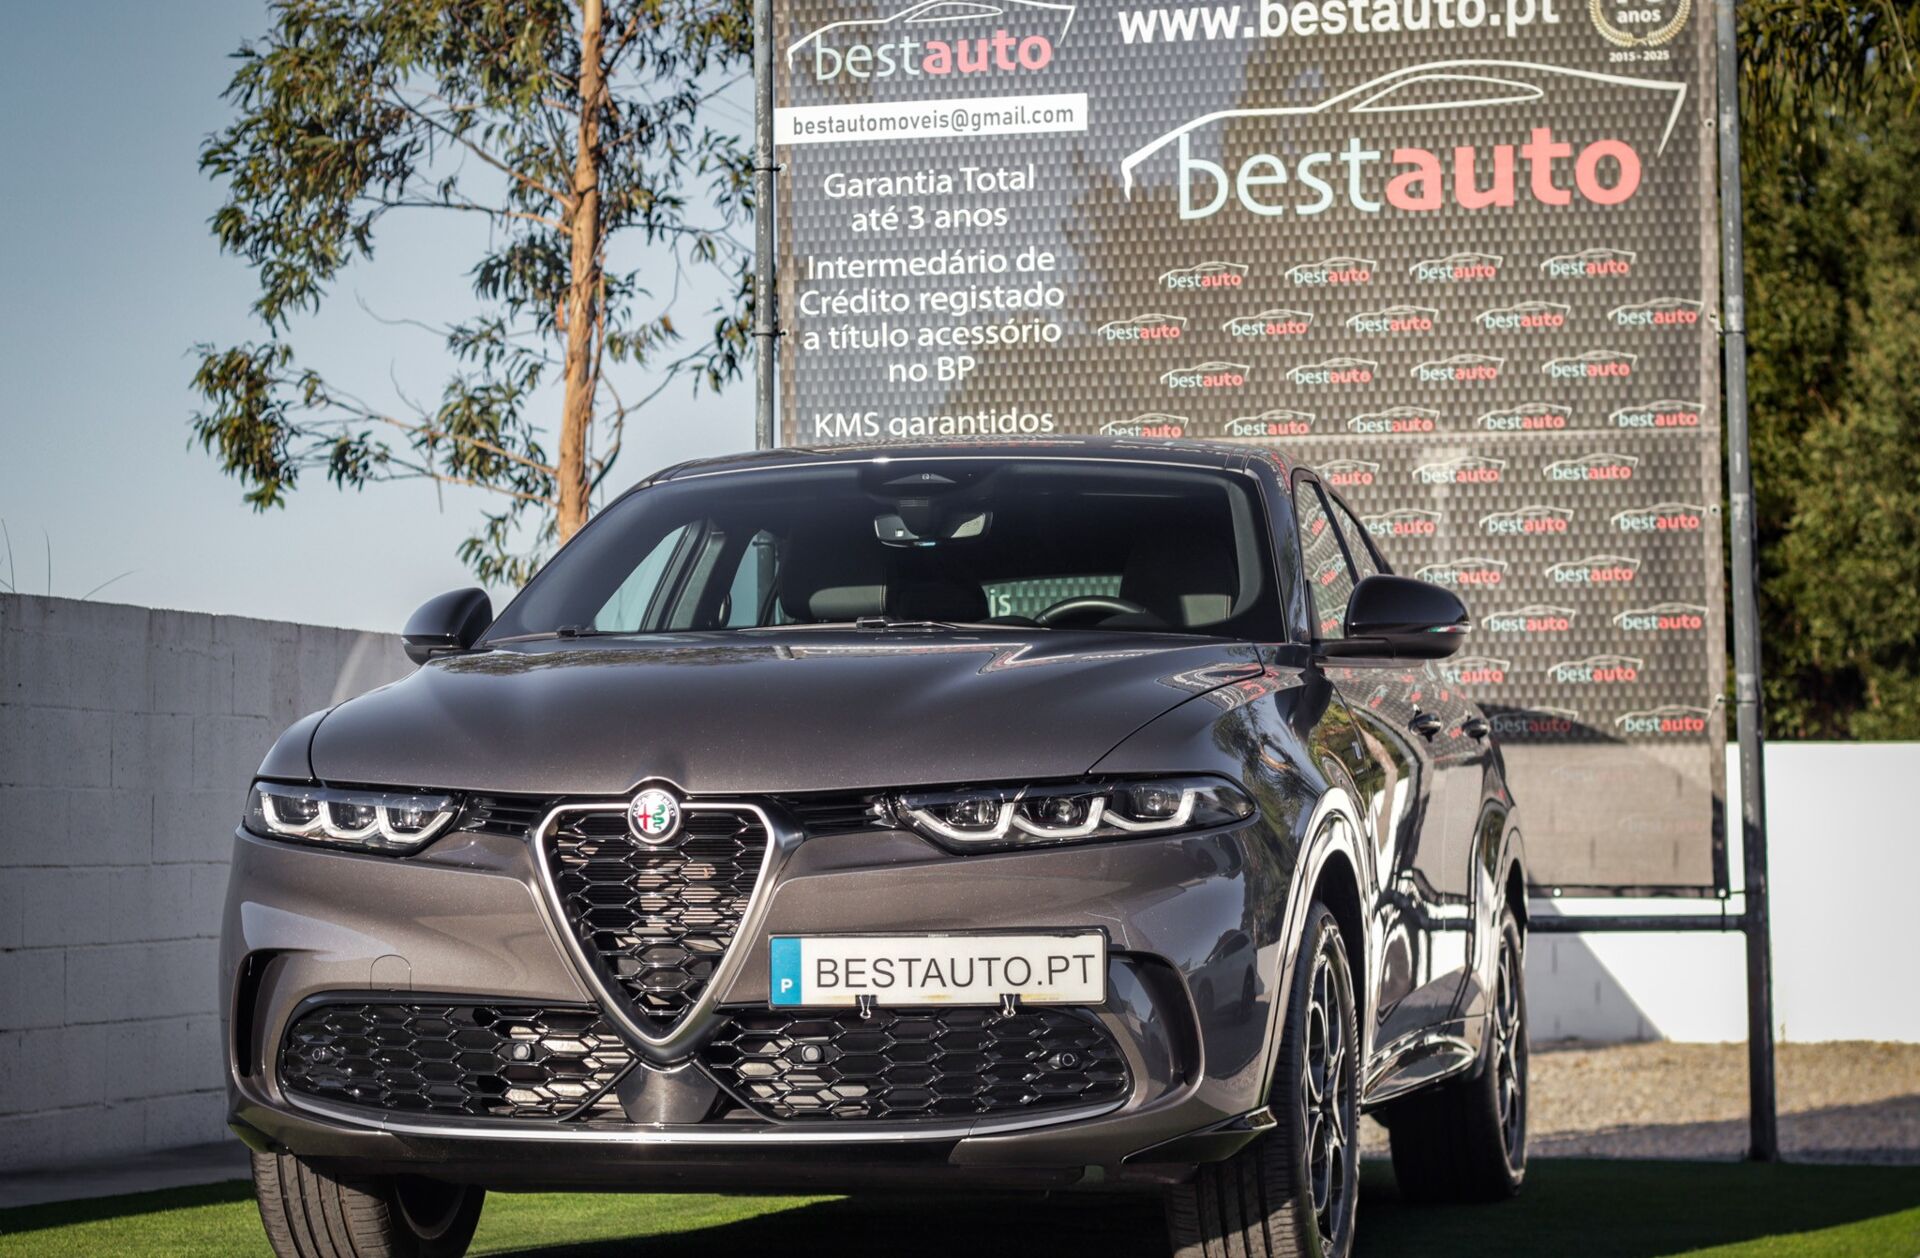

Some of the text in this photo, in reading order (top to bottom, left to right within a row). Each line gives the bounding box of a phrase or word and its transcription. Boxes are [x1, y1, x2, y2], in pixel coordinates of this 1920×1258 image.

[1118, 0, 1560, 44] www.bestauto.pt
[1616, 9, 1662, 24] anos
[814, 29, 1052, 81] bestauto
[1608, 51, 1636, 63] 2015
[1643, 50, 1670, 61] 2025
[793, 106, 1074, 135] bestautomoveis@gmail.com
[824, 163, 1035, 198] Garantia Total
[1178, 127, 1642, 220] bestauto
[851, 205, 1008, 232] até 3 anos
[808, 245, 1056, 280] Intermedário de
[1550, 260, 1629, 276] bestauto
[1167, 272, 1242, 288] bestauto
[1294, 268, 1370, 284] bestauto
[1418, 264, 1496, 280] bestauto
[799, 281, 1065, 316] Crédito registado
[1355, 316, 1432, 333] bestauto
[1485, 312, 1564, 329] bestauto
[1617, 308, 1698, 325] bestauto
[803, 318, 1062, 350] a título acessório
[1106, 323, 1181, 340] bestauto
[1231, 320, 1308, 336] bestauto
[888, 356, 975, 383] no BP
[1295, 369, 1372, 385] bestauto
[1419, 365, 1497, 381] bestauto
[1551, 361, 1630, 378] bestauto
[1168, 372, 1243, 388] bestauto
[815, 407, 1054, 438] KMS garantidos
[1357, 417, 1433, 433] bestauto
[1487, 413, 1565, 430] bestauto
[1619, 410, 1698, 427] bestauto
[1108, 424, 1182, 438] bestauto
[1233, 420, 1309, 437] bestauto
[1421, 468, 1499, 484] bestauto
[1553, 465, 1632, 480] bestauto
[1367, 519, 1435, 535] estauto
[1488, 517, 1567, 532] bestauto
[1620, 514, 1700, 530] bestauto
[1423, 569, 1500, 584] bestauto
[1555, 567, 1634, 582] bestauto
[1491, 615, 1569, 632] bestauto
[1622, 614, 1702, 630] bestauto
[1443, 667, 1504, 684] stauto
[1556, 665, 1636, 682] bestauto
[1493, 715, 1571, 732] bestauto
[1625, 715, 1705, 732] bestauto
[815, 954, 1096, 989] BESTAUTO.PT
[781, 978, 793, 993] P
